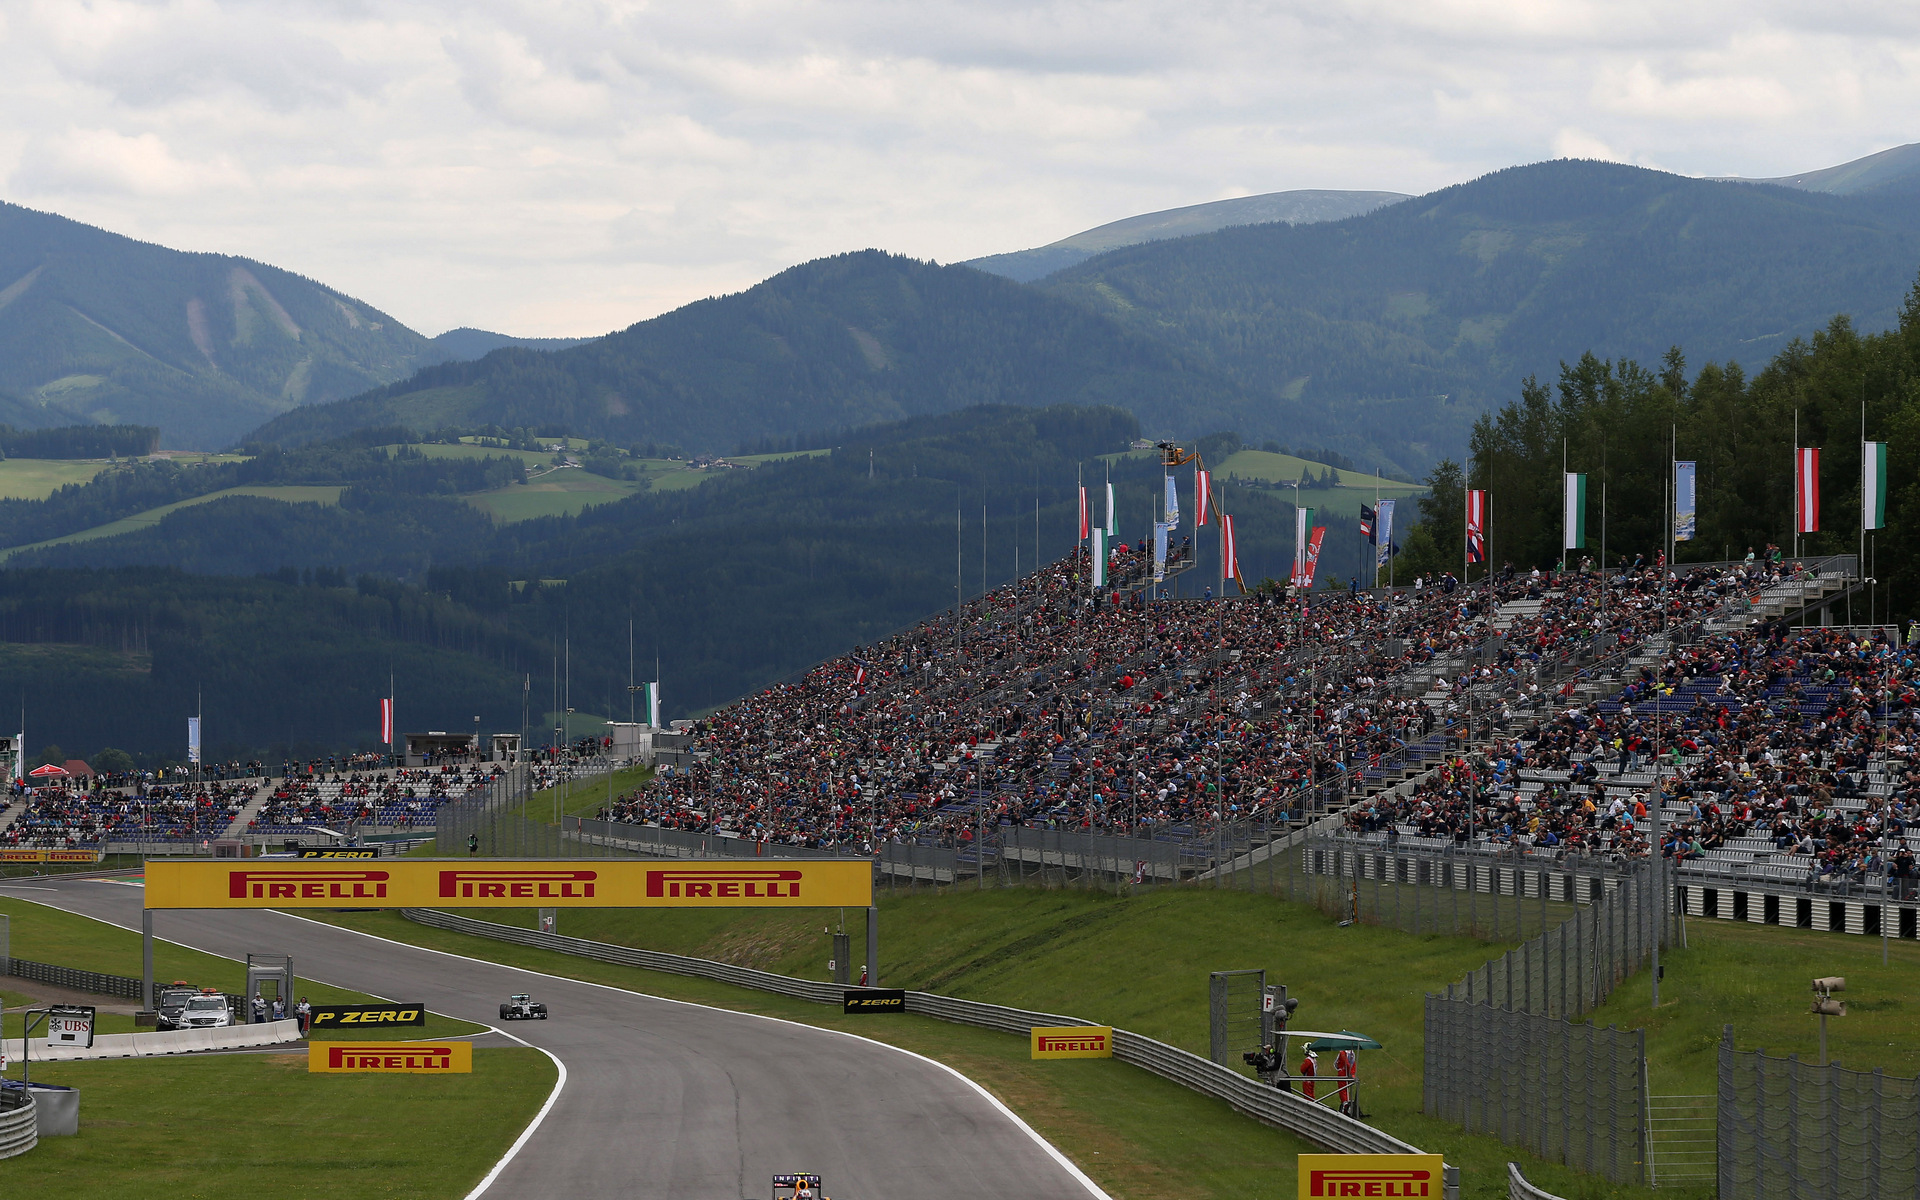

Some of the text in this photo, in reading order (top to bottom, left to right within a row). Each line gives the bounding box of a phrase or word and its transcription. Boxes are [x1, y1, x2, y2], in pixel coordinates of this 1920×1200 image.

[229, 871, 389, 898] PIRELLI
[439, 871, 597, 897] PIRELLI
[646, 870, 802, 897] PIRELLI
[1266, 998, 1272, 1009] F
[64, 1020, 89, 1032] UBS
[314, 1010, 419, 1024] P ZERO
[1038, 1035, 1105, 1052] PIRELLI
[328, 1047, 452, 1068] PIRELLI
[1310, 1170, 1431, 1197] PIRELLI
